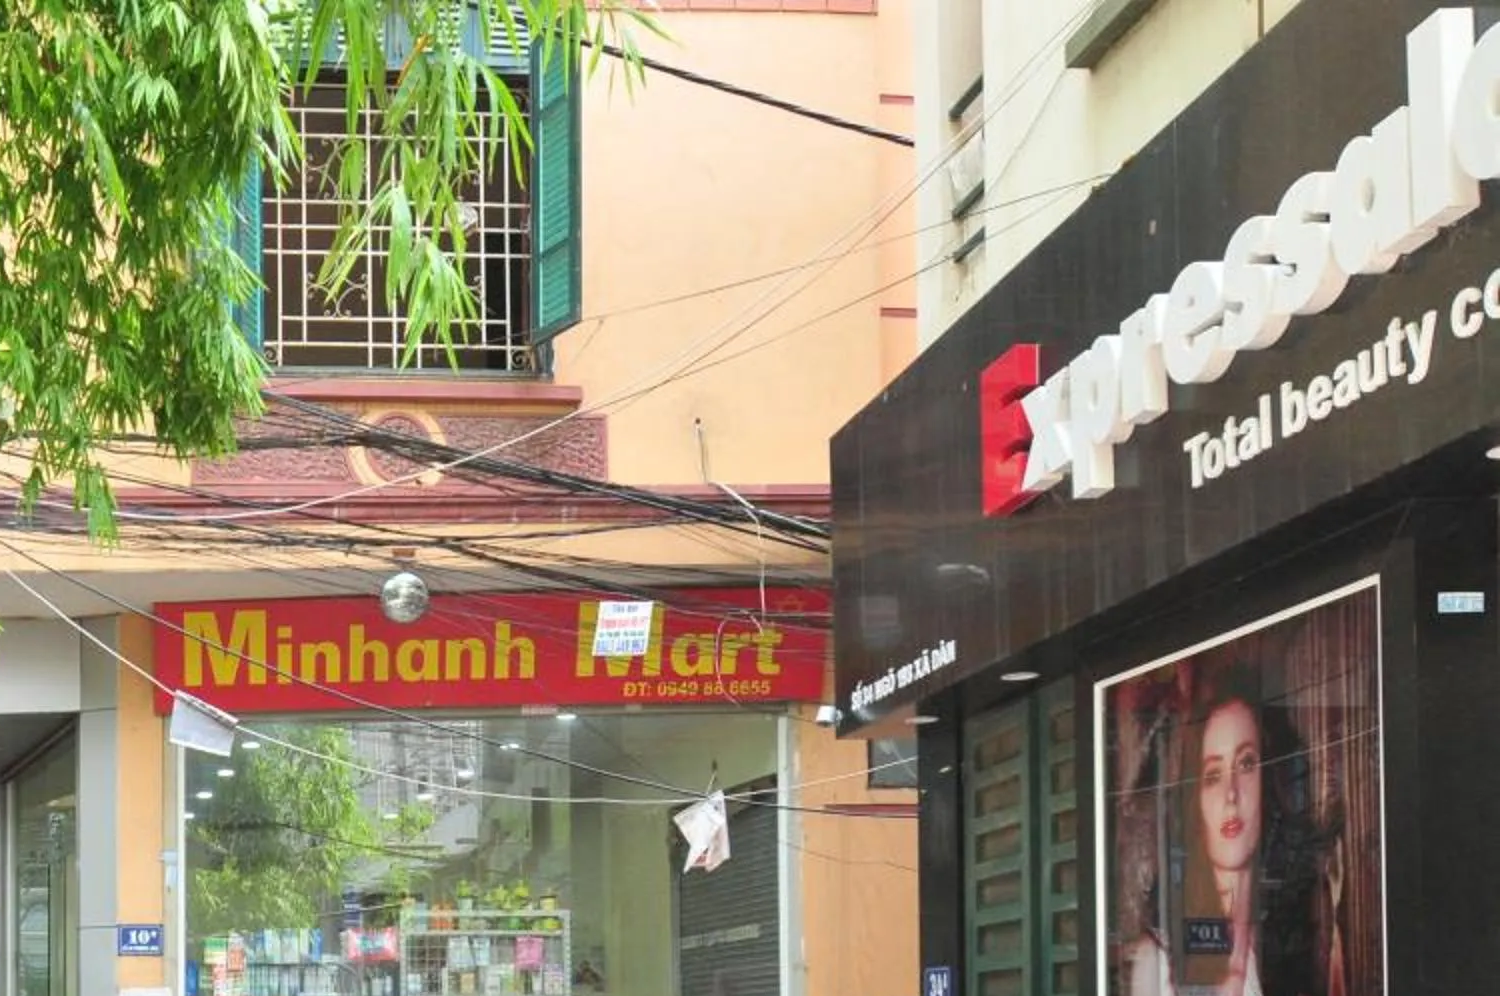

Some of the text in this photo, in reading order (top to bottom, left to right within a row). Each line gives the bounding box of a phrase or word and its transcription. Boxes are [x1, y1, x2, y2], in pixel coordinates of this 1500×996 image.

[1184, 394, 1272, 488] Total
[1280, 310, 1437, 438] beauty
[182, 609, 535, 688] Minhanh
[913, 649, 931, 681] XÃ
